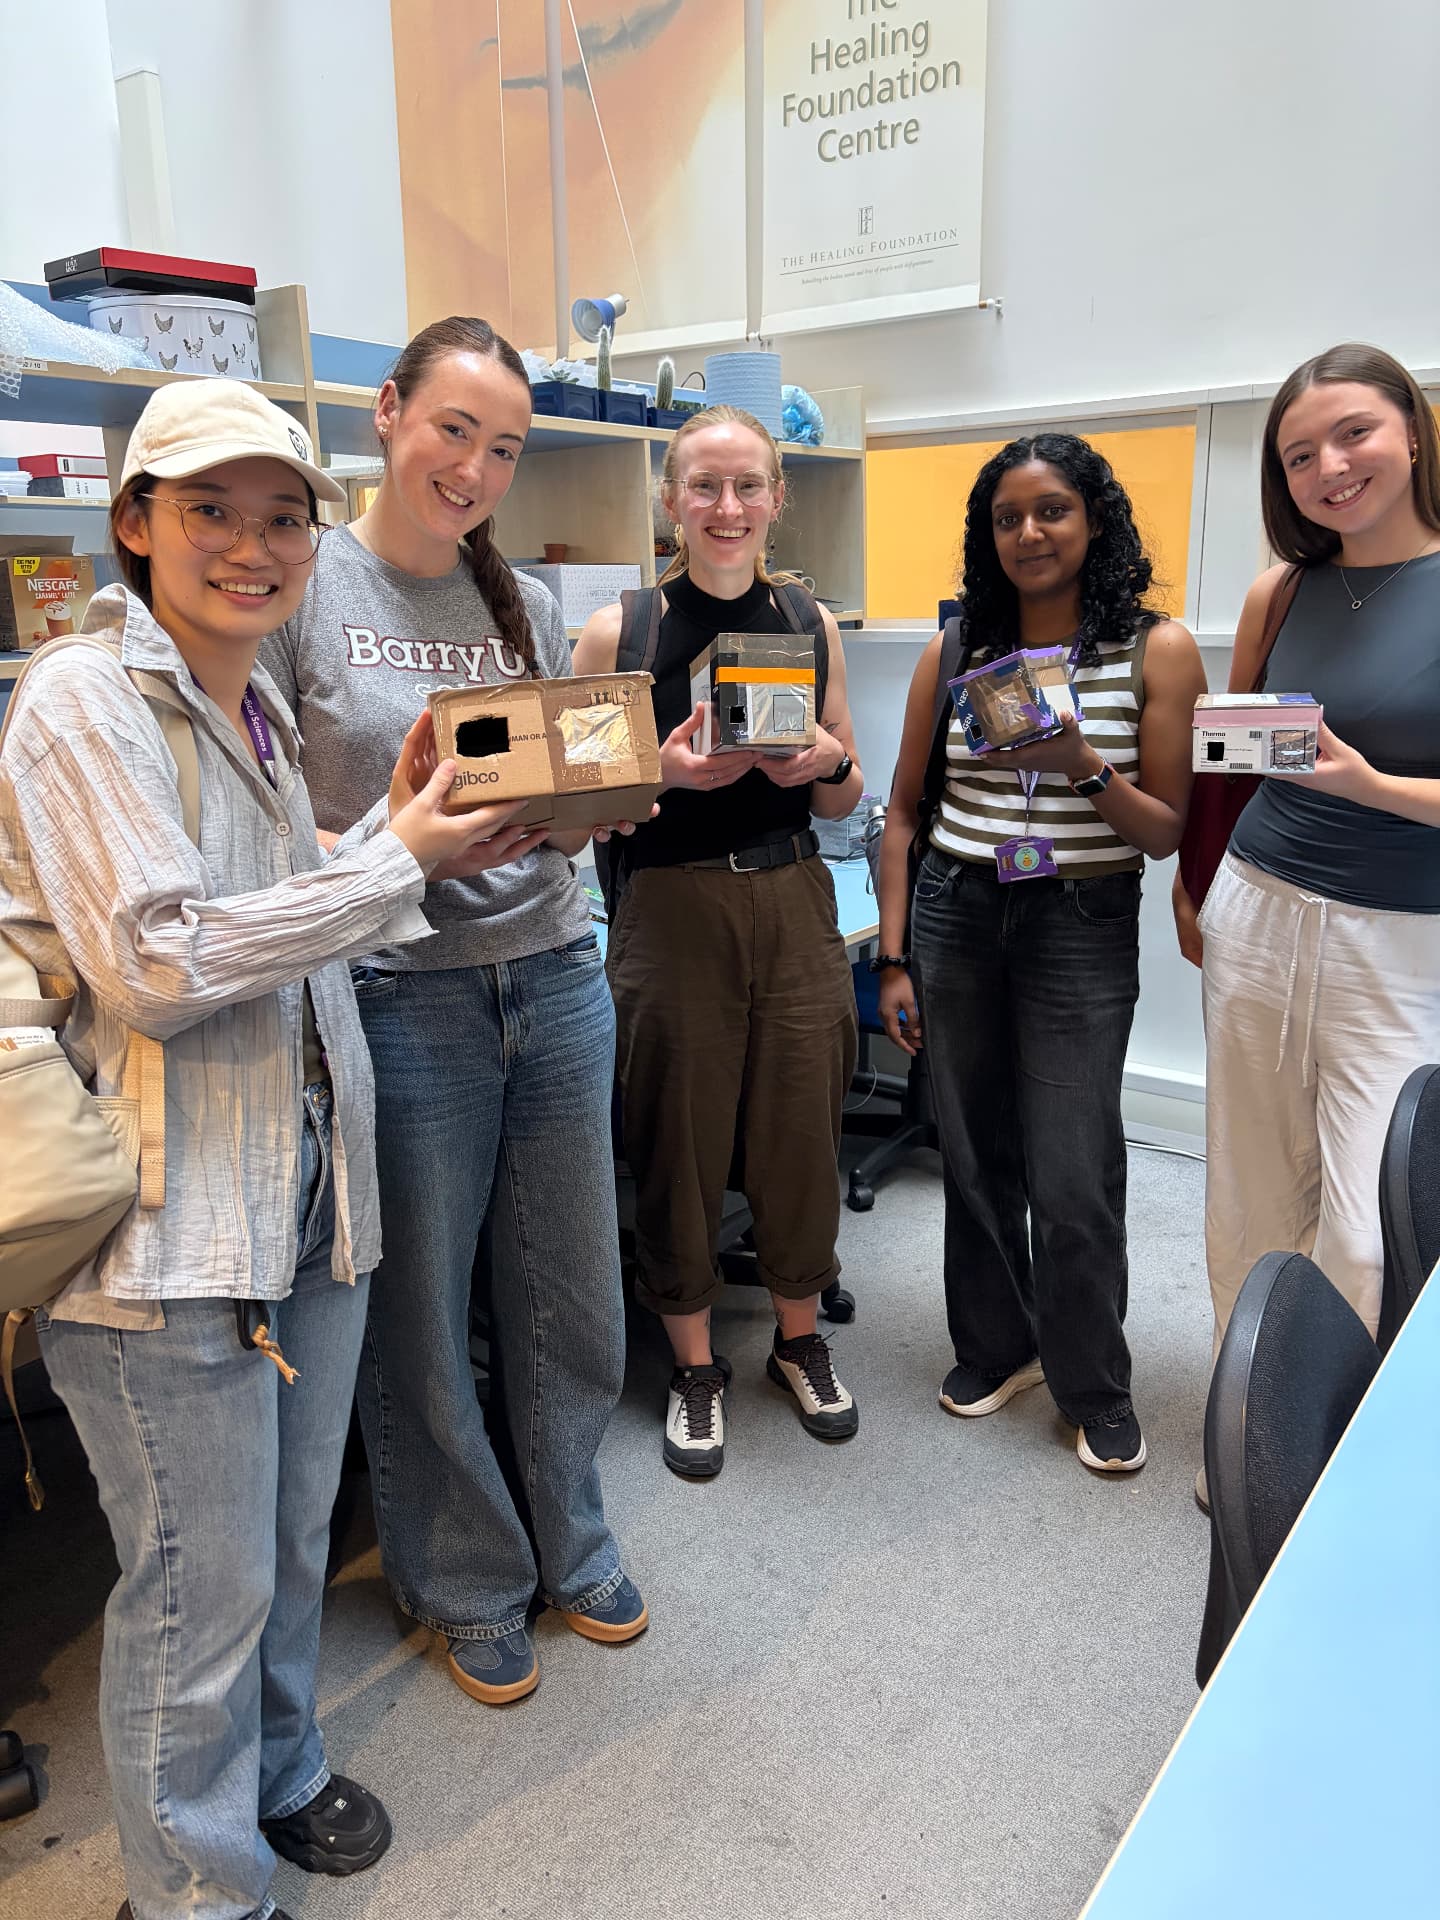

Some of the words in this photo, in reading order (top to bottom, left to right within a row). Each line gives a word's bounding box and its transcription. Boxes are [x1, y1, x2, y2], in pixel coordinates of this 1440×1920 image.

[811, 20, 930, 75] Healing
[783, 60, 961, 127] Foundation
[818, 118, 919, 163] Centre
[781, 255, 805, 268] THE
[810, 244, 864, 264] HEALING
[870, 228, 958, 253] FOUNDATION
[27, 574, 80, 591] NESCAFÉ
[342, 623, 487, 683] Barry
[251, 716, 267, 752] Sciences
[508, 733, 529, 742] MAN
[530, 732, 541, 740] OR
[454, 770, 499, 790] gibco
